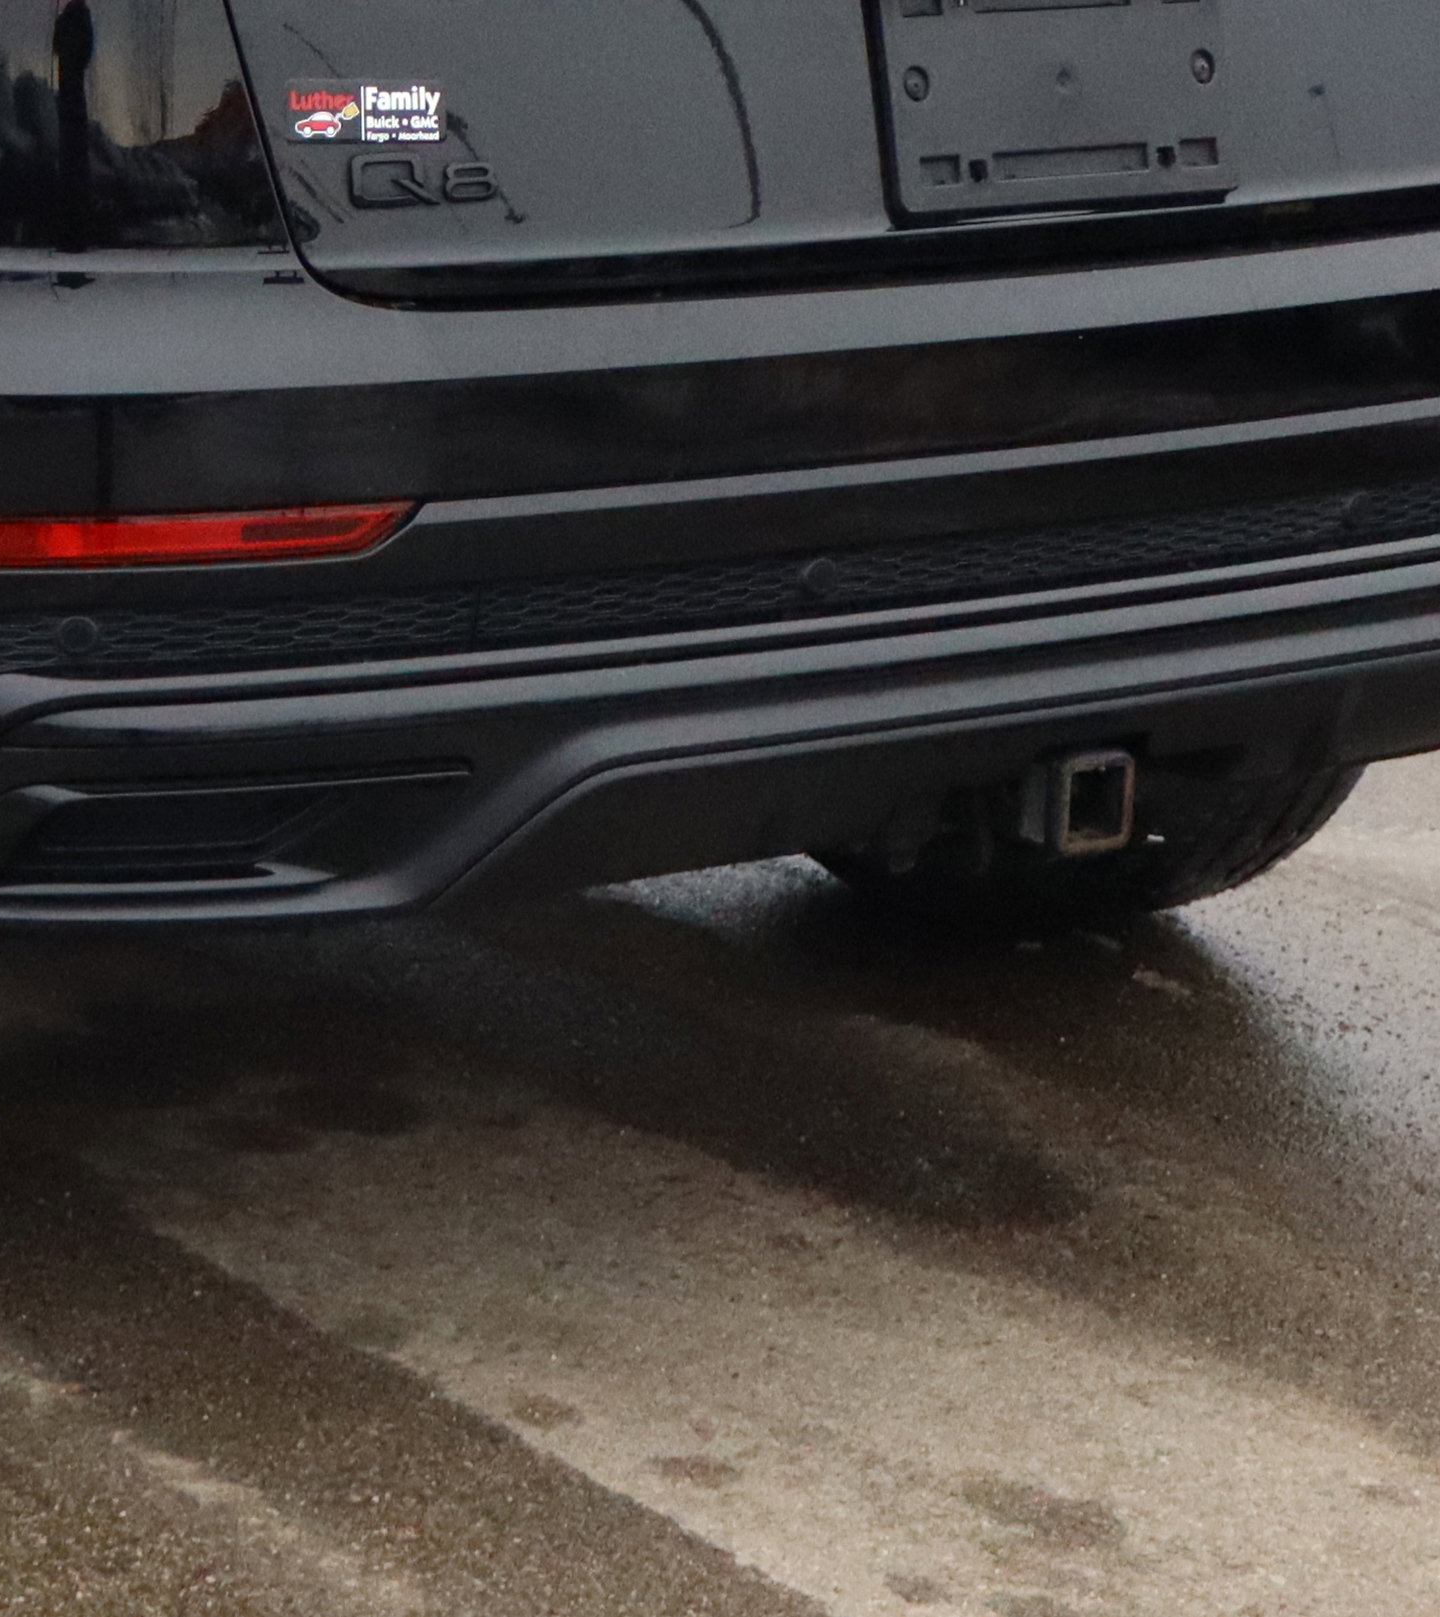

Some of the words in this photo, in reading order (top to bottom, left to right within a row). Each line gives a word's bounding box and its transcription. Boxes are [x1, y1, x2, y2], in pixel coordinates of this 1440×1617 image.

[290, 90, 354, 110] Luther
[365, 85, 441, 115] Family
[366, 115, 400, 130] Buick
[410, 115, 439, 130] GMC
[366, 130, 391, 143] Fargo
[397, 130, 440, 141] Moorhead
[351, 152, 498, 209] Q8
